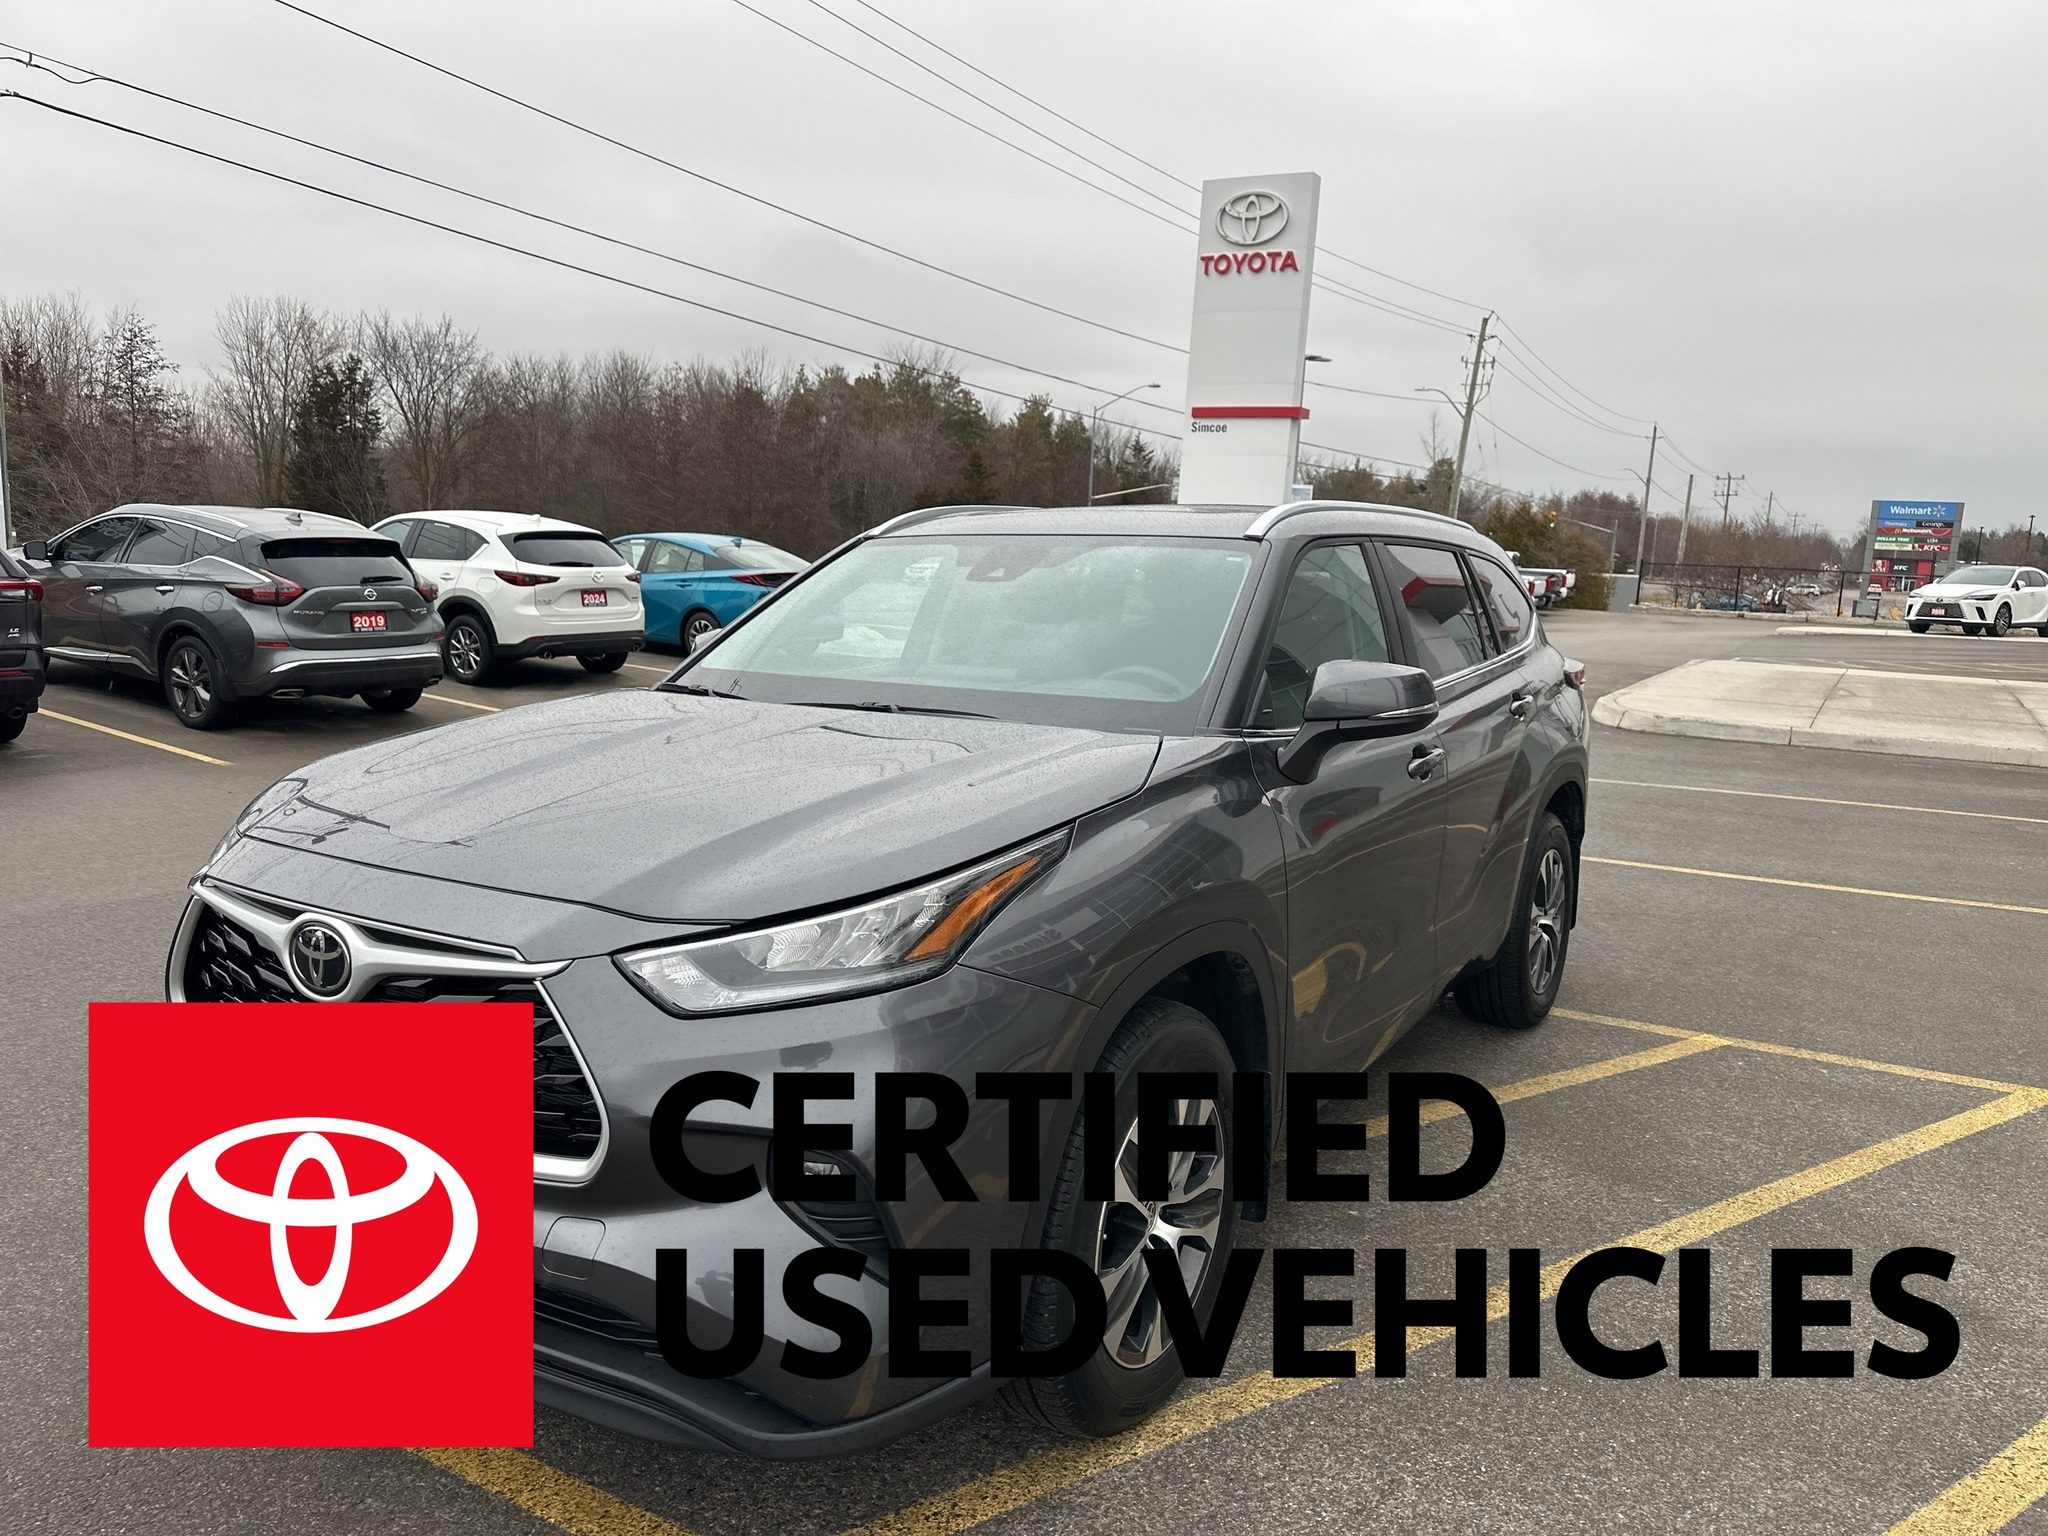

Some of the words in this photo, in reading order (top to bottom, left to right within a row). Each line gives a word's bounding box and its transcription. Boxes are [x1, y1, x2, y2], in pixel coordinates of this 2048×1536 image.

[1200, 251, 1299, 276] TOYOTA
[1191, 421, 1228, 433] Simcoe
[1890, 505, 1931, 515] Walmart
[583, 594, 606, 603] 2024
[354, 616, 384, 628] 2019
